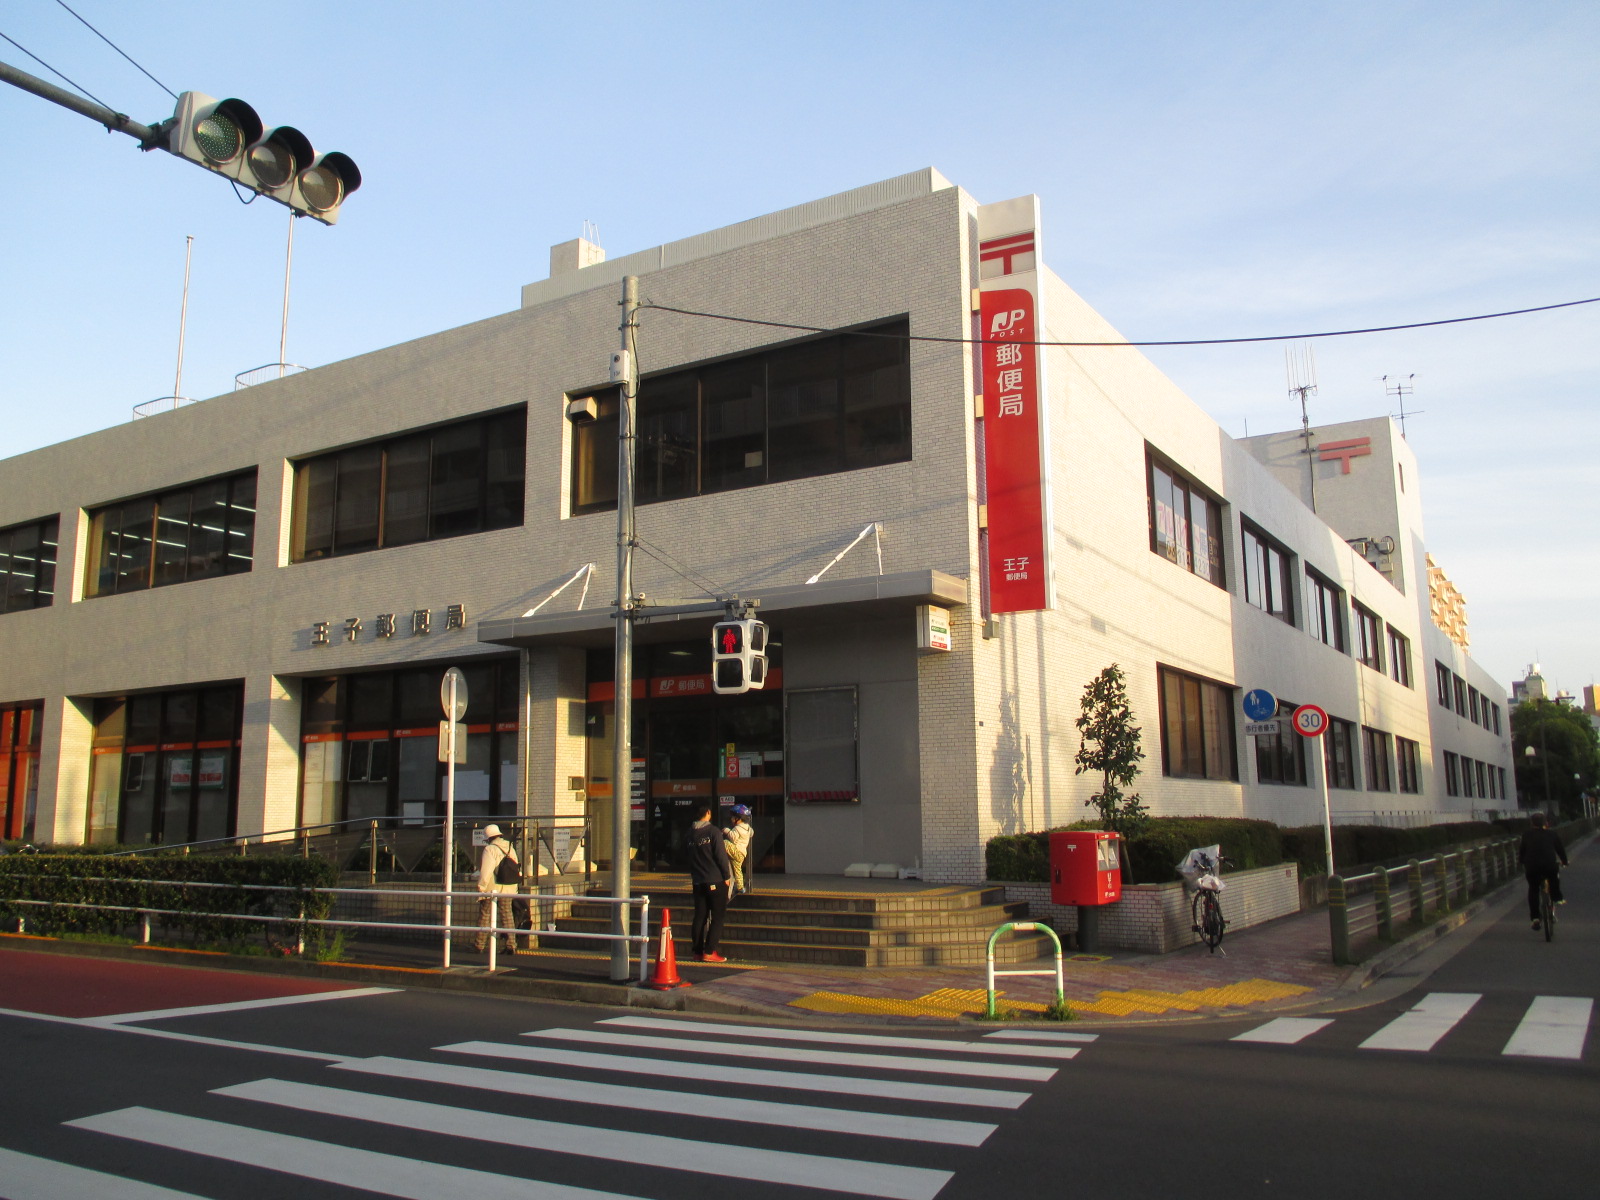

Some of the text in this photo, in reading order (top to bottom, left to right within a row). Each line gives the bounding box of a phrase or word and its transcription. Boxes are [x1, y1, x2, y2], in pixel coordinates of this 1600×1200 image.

[991, 309, 1025, 332] JP
[990, 328, 1025, 339] POST
[996, 343, 1023, 418] 郵便局
[1003, 557, 1029, 572] 王子
[1006, 572, 1028, 581] 郵便局
[312, 603, 466, 645] 王子郵便局
[678, 679, 705, 690] 郵便局
[1300, 713, 1320, 728] 30
